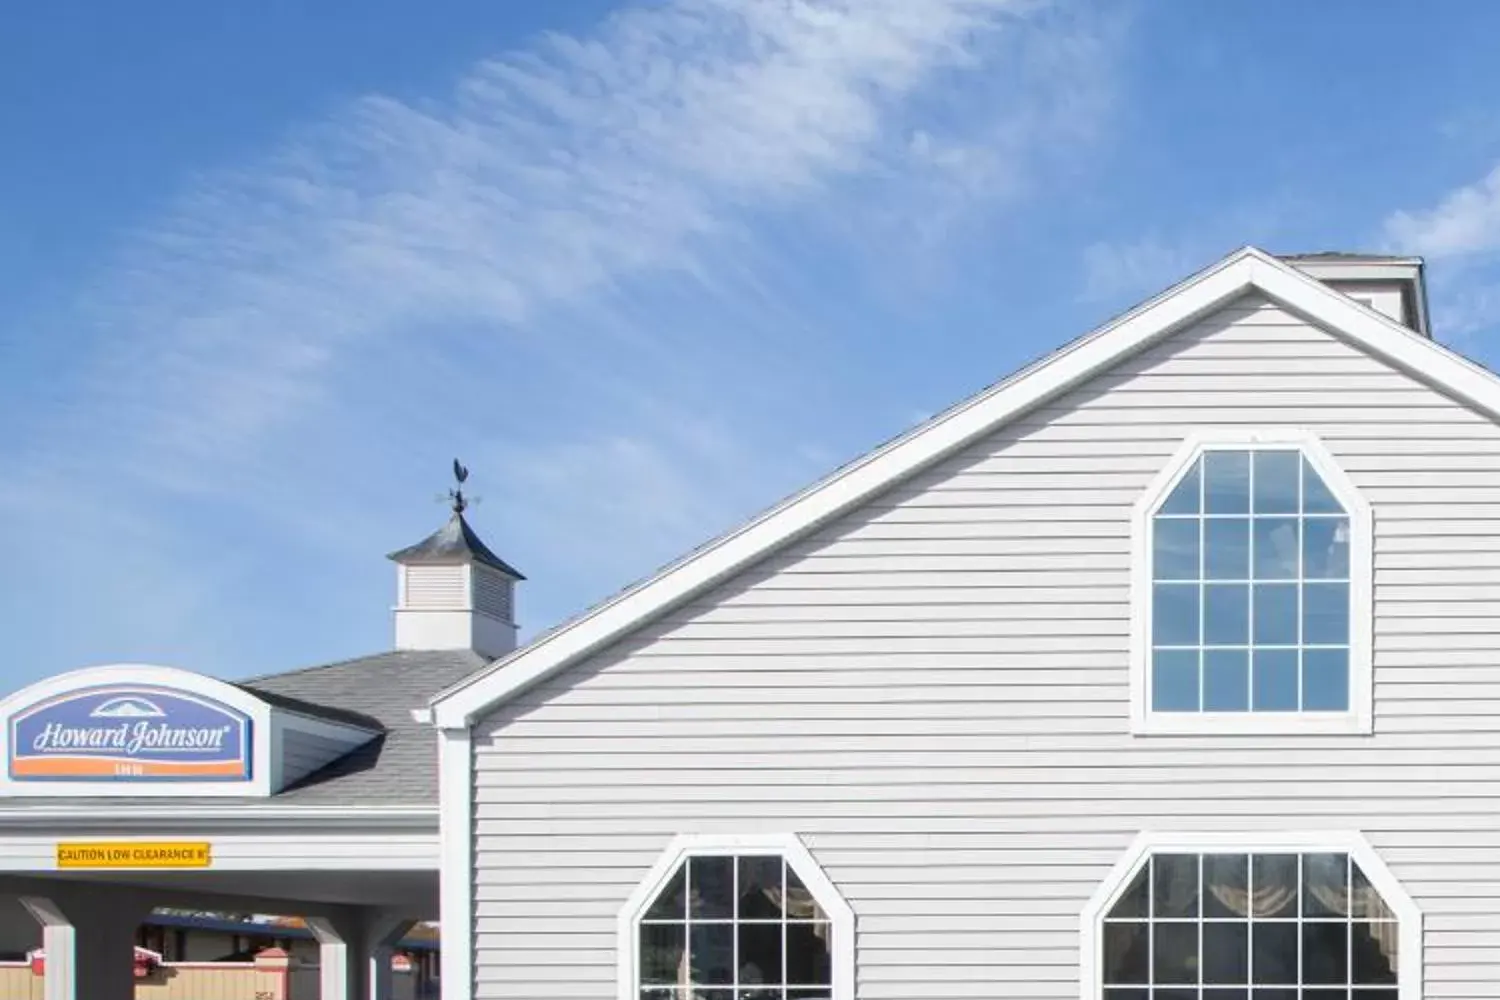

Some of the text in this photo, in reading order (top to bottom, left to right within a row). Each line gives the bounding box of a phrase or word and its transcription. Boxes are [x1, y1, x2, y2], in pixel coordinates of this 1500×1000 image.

[33, 723, 129, 751] Howard
[59, 847, 105, 861] CAUTION
[107, 848, 129, 860] LOW
[133, 847, 194, 860] CLEARANCE
